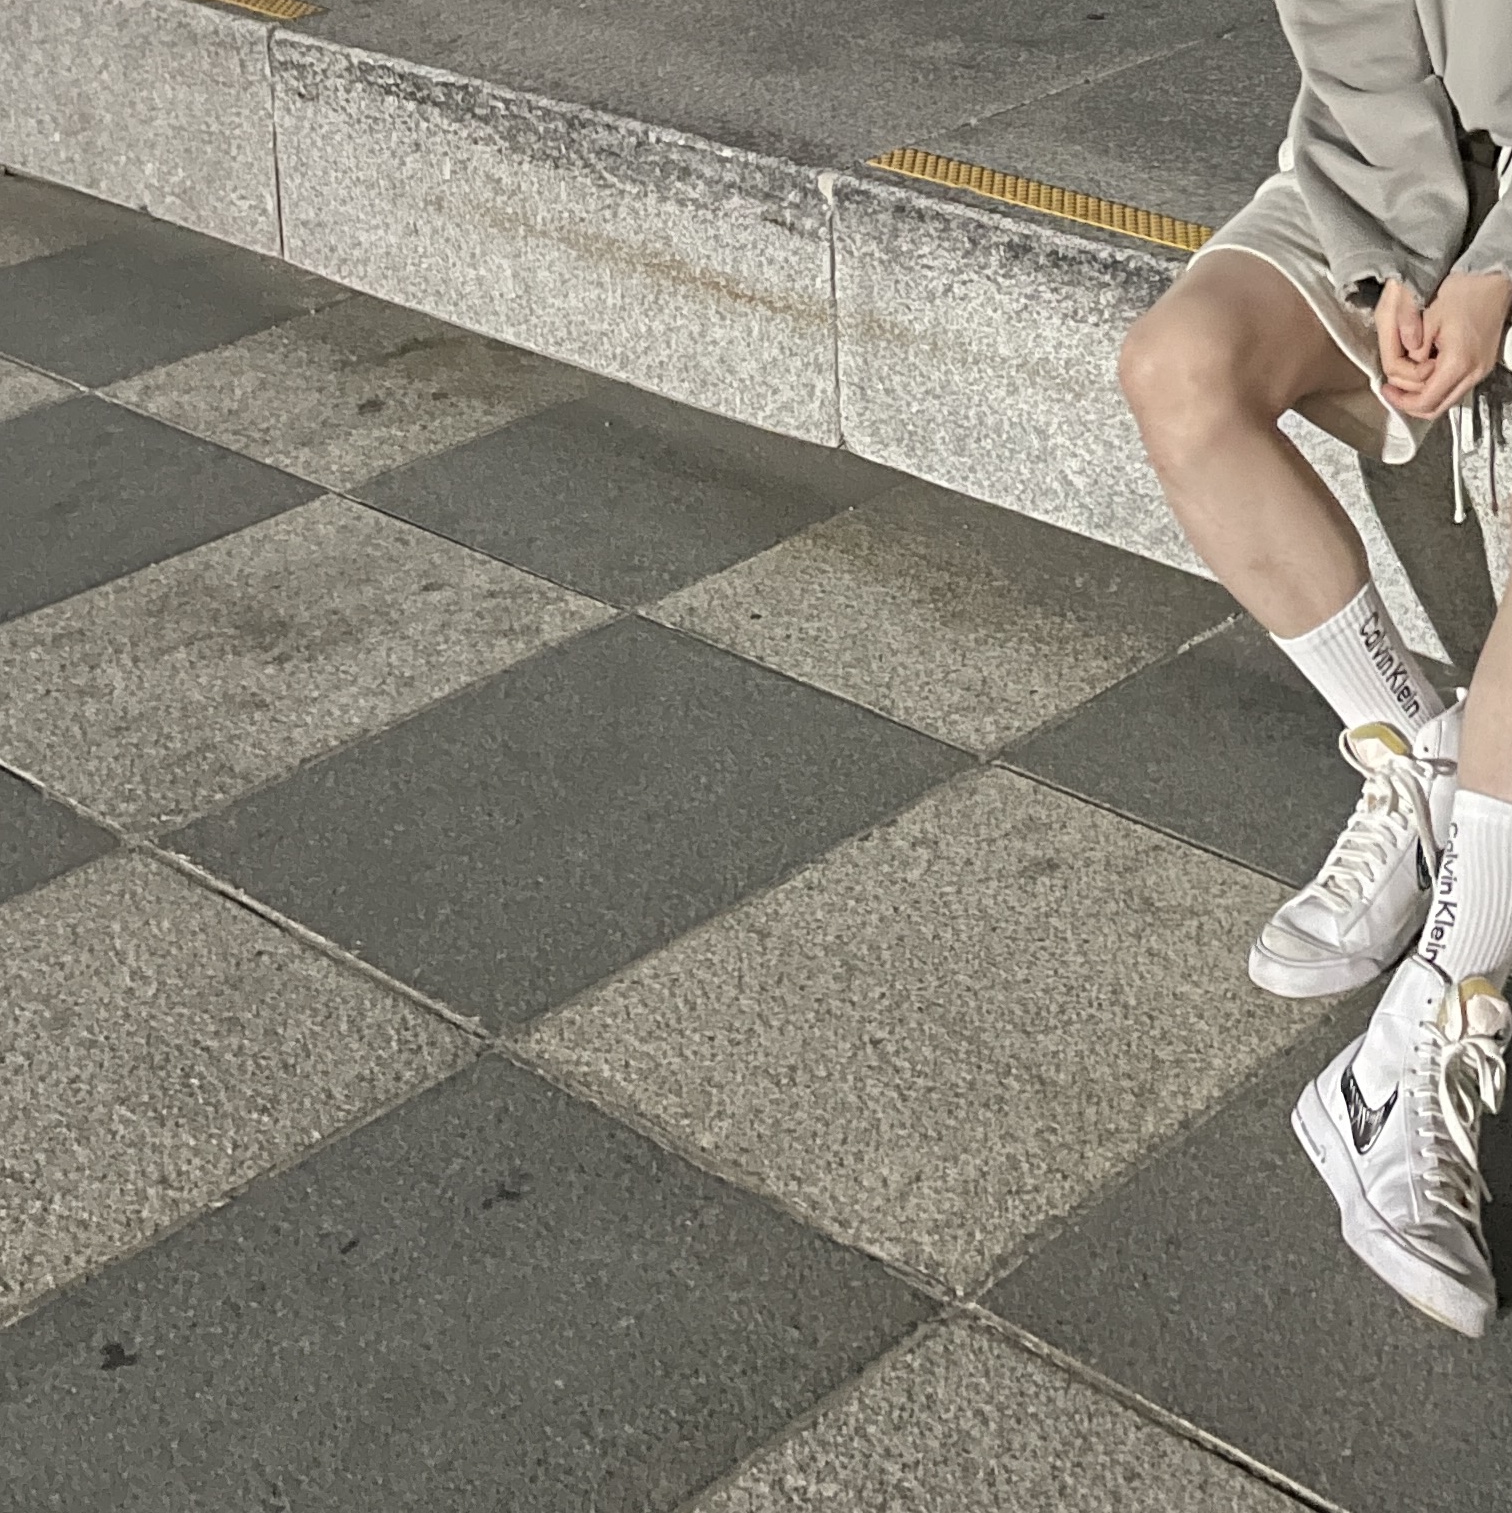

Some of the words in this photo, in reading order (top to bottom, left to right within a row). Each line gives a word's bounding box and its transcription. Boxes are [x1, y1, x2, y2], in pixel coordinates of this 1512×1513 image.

[1360, 612, 1394, 676] Calvin
[1386, 661, 1420, 718] Klein
[1425, 899, 1458, 963] Klein
